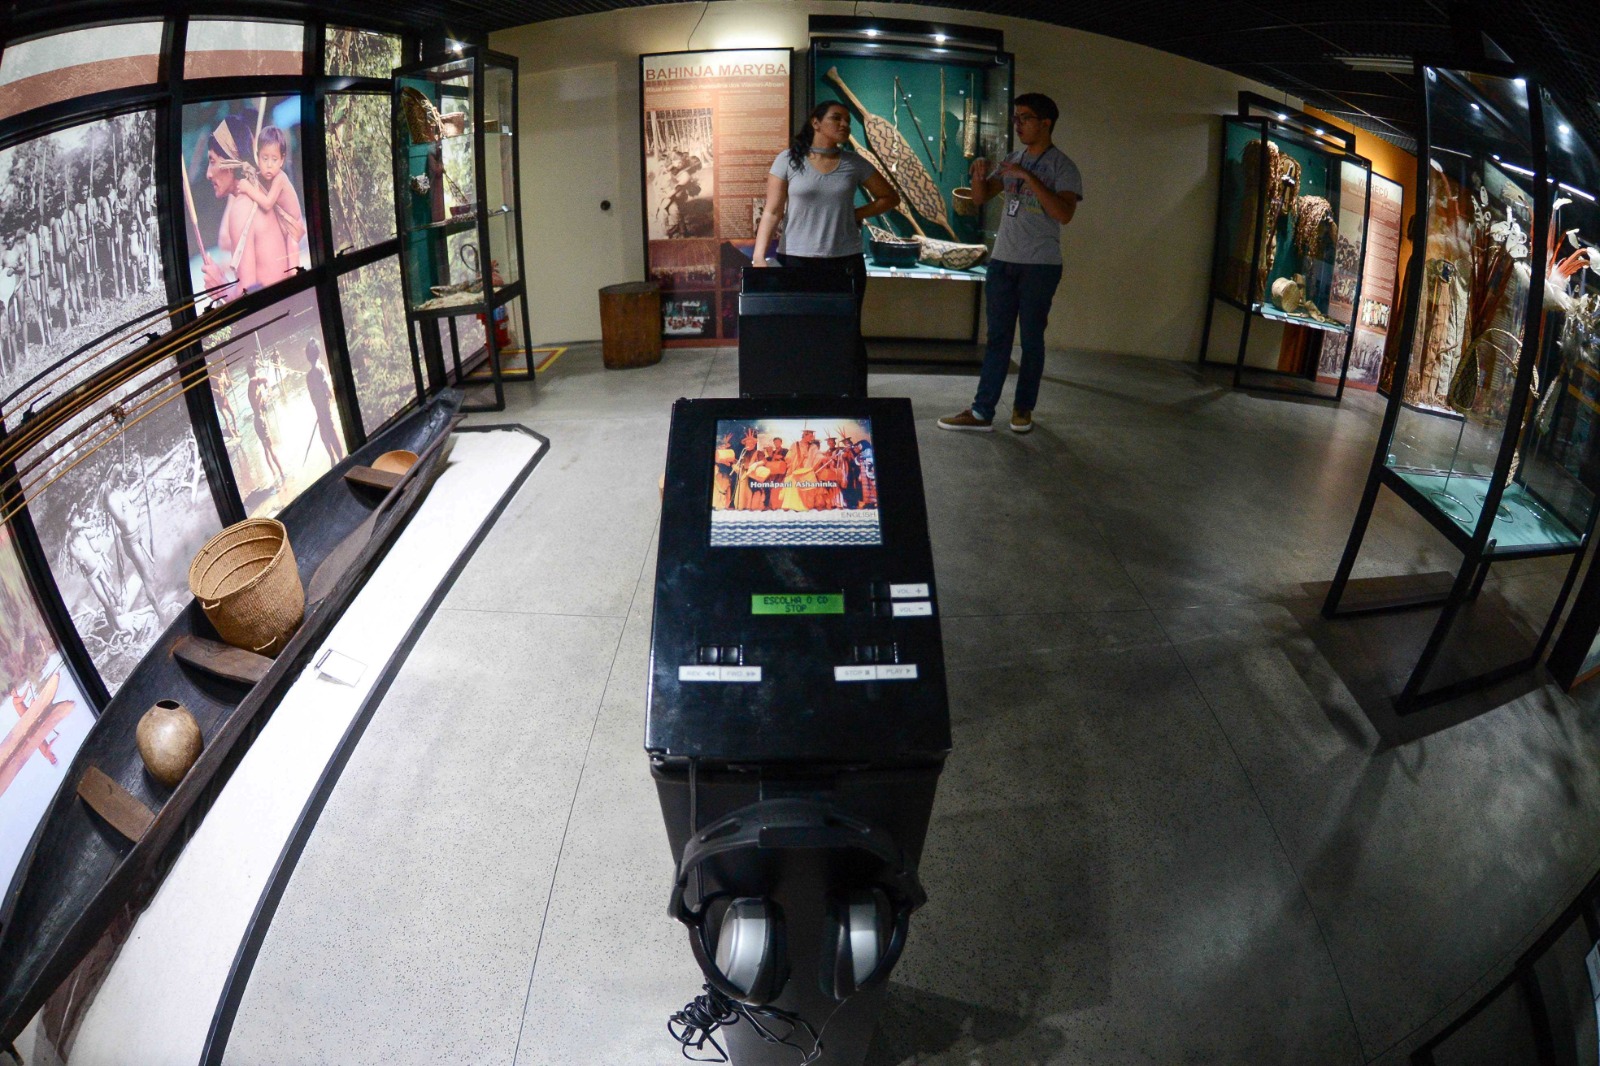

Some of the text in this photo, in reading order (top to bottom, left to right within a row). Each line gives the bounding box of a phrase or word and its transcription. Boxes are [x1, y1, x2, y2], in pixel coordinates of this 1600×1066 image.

[645, 63, 787, 80] BAHINJA MARYBA
[795, 480, 837, 488] Ashaninka
[763, 596, 801, 605] ESCOLHA
[785, 604, 807, 613] STOP
